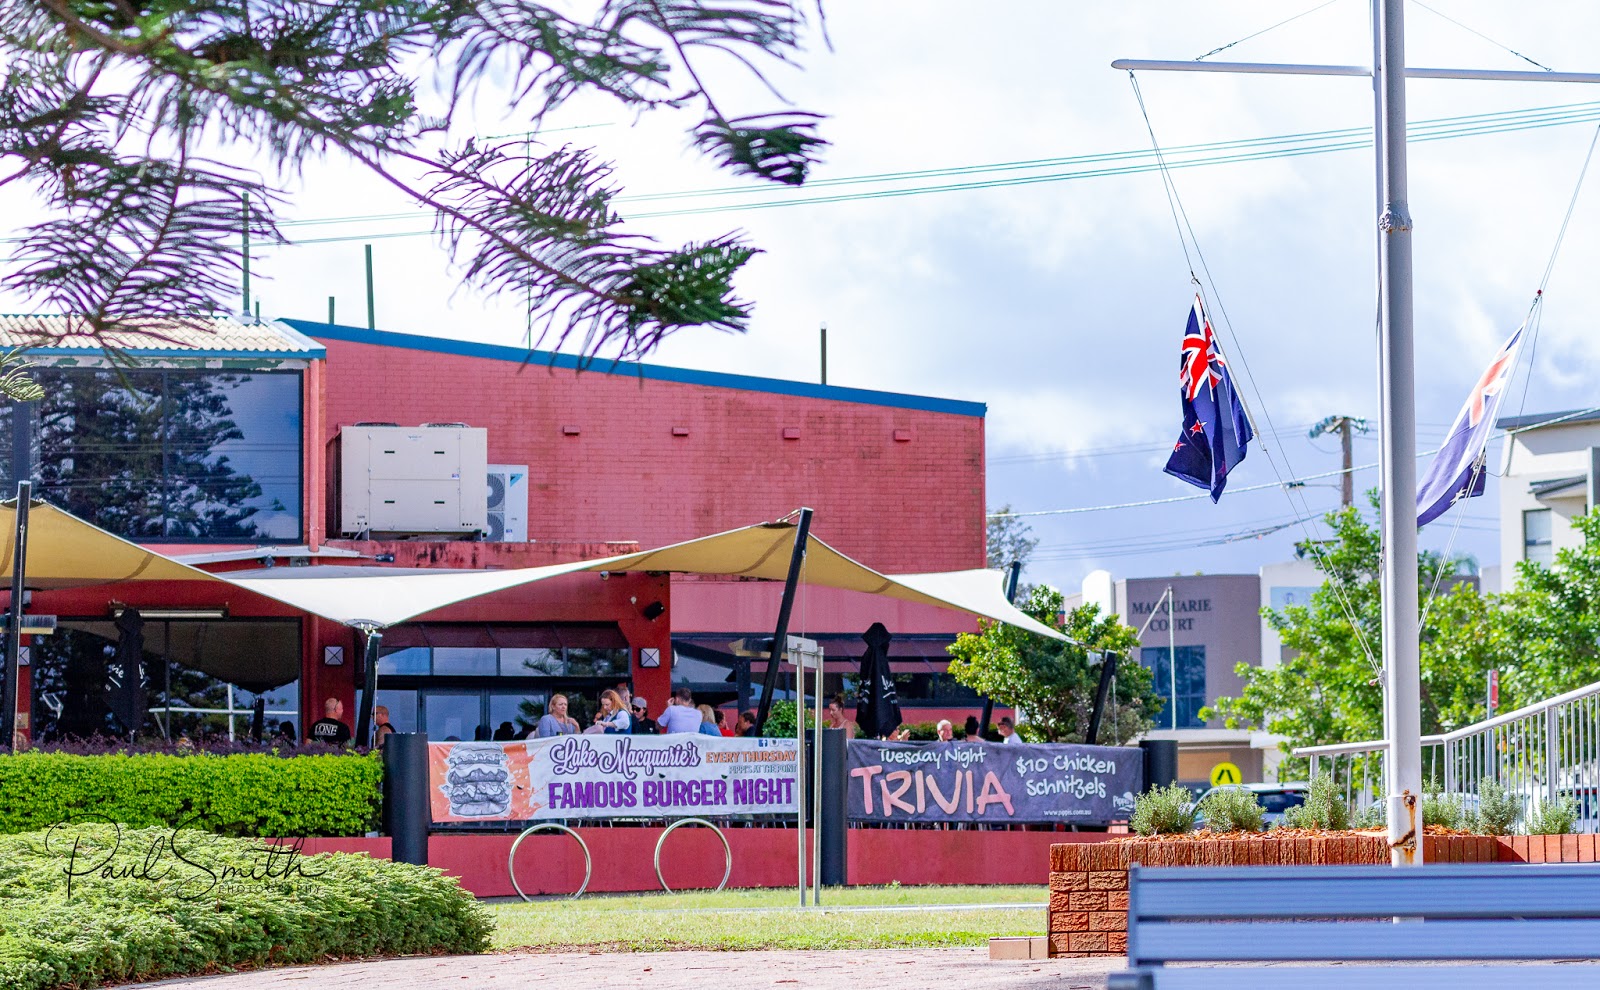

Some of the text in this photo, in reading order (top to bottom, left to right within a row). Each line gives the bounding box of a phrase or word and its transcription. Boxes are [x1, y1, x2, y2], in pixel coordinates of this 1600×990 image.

[1132, 599, 1212, 615] MACQUARIE
[550, 737, 701, 780] Lake Macquarie's
[706, 750, 797, 763] EVERY THURSDAY
[878, 747, 987, 769] Tuesday Night
[1016, 754, 1116, 777] $10 Chicken
[549, 778, 795, 808] FAMOUS BURGER NIGHT
[851, 765, 1015, 817] TRIVIA
[1026, 775, 1107, 799] Schnitzels
